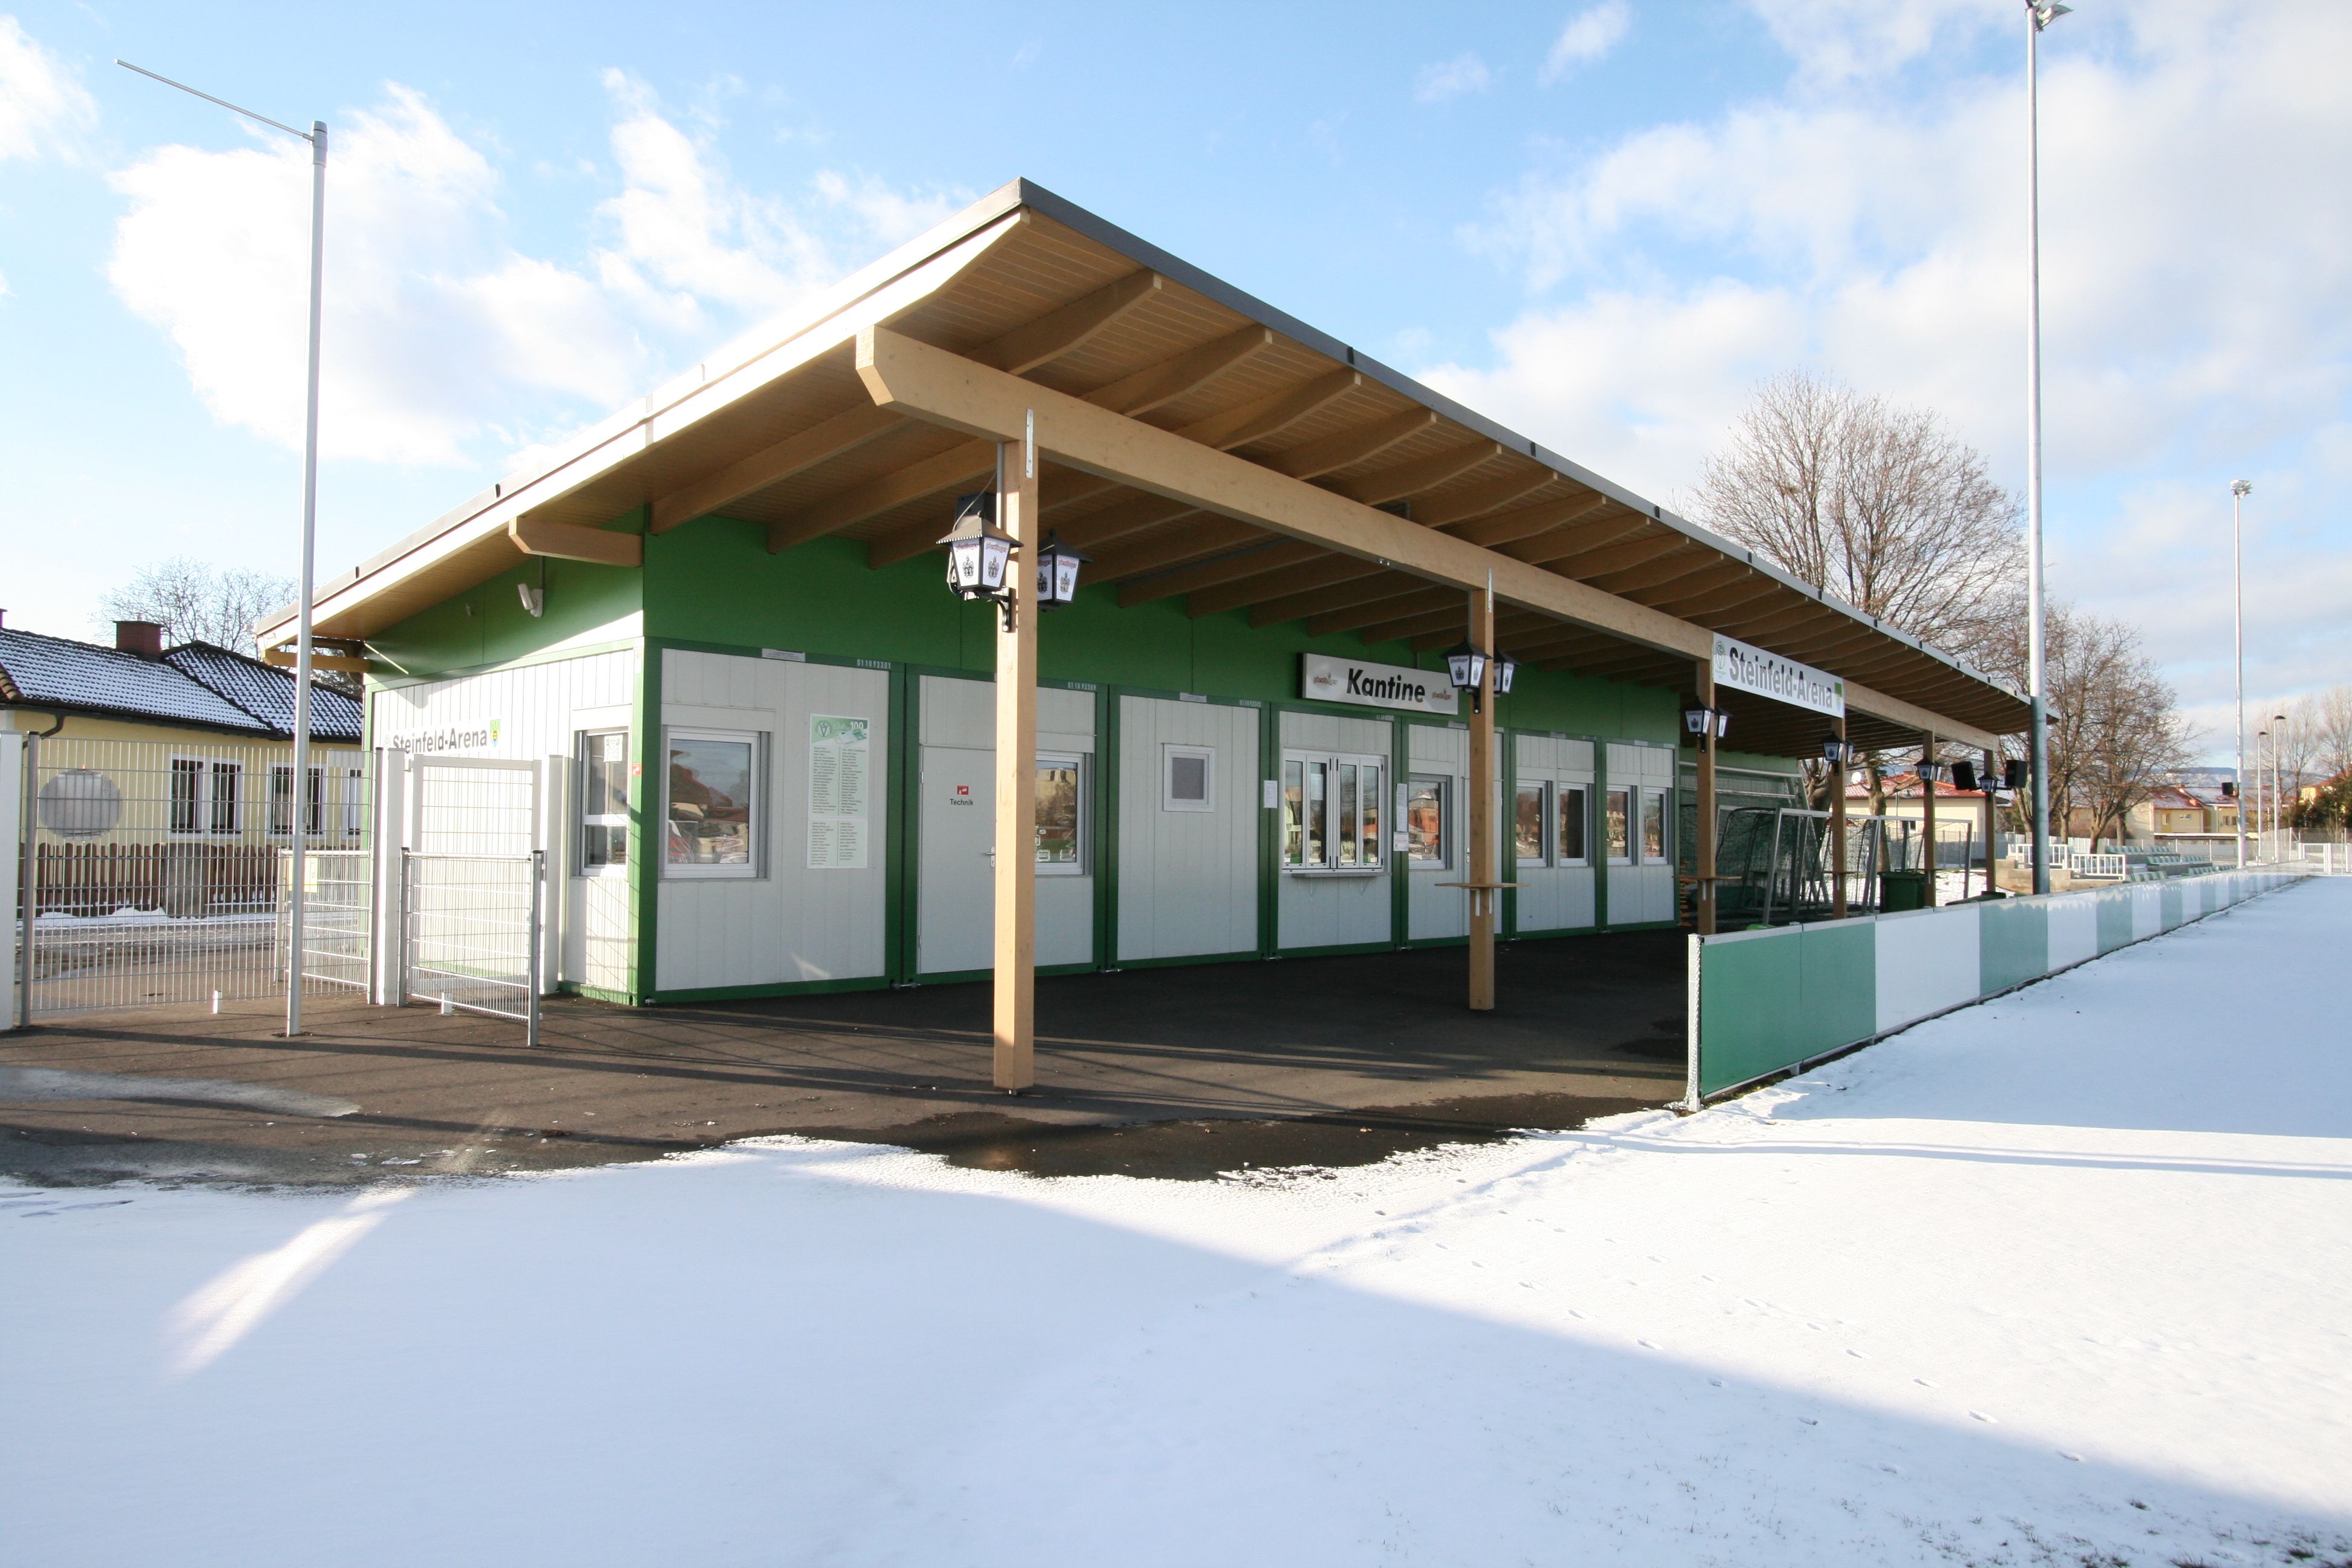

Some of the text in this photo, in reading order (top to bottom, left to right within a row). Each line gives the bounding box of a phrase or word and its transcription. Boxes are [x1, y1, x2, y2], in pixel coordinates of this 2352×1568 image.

[1347, 668, 1425, 703] Kantine
[1729, 647, 1833, 709] Steinfeld-Arena
[393, 728, 488, 754] Steinfeld-Arena
